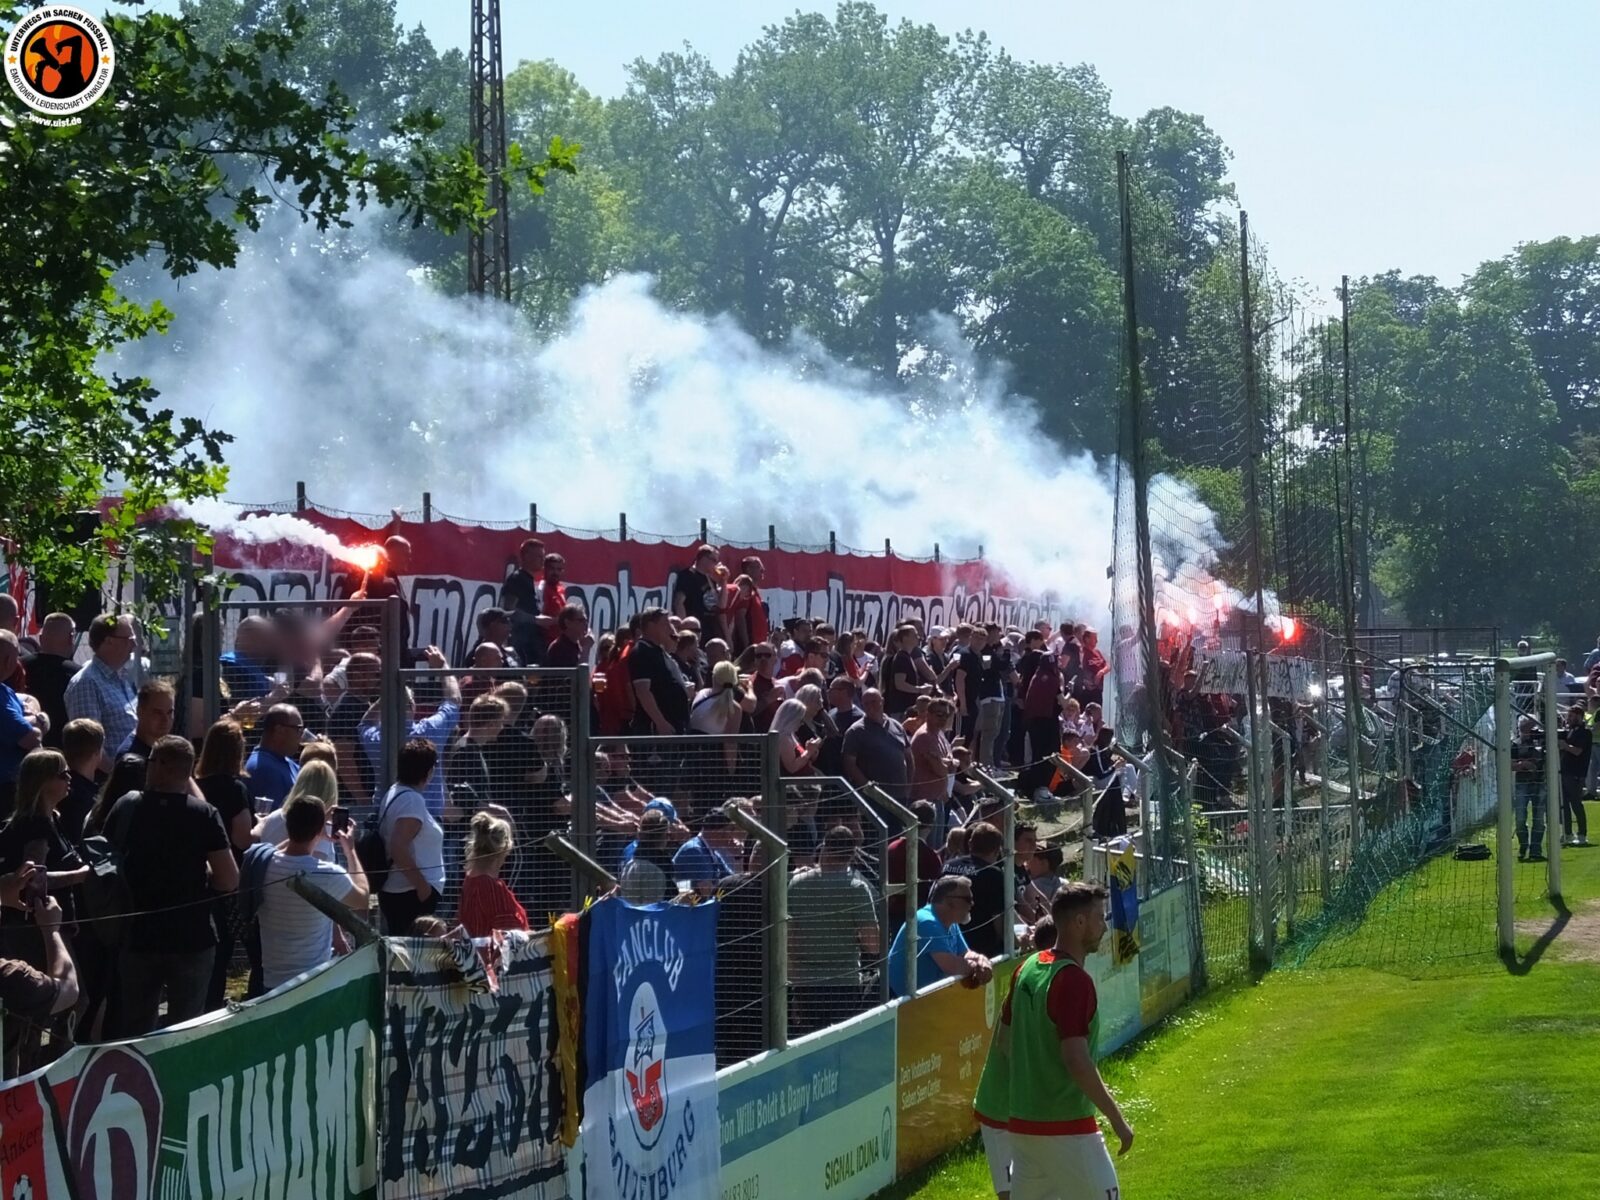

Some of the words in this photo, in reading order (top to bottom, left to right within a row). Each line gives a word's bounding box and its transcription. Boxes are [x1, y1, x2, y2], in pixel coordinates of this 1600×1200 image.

[613, 917, 684, 1004] FANCLUB
[736, 1100, 755, 1138] Willi
[757, 1091, 778, 1129] Boldt
[780, 1090, 786, 1118] &
[787, 1084, 811, 1115] Danny
[812, 1068, 839, 1102] Richter
[825, 1150, 855, 1190] SIGNAL
[856, 1136, 879, 1174] IDUNA
